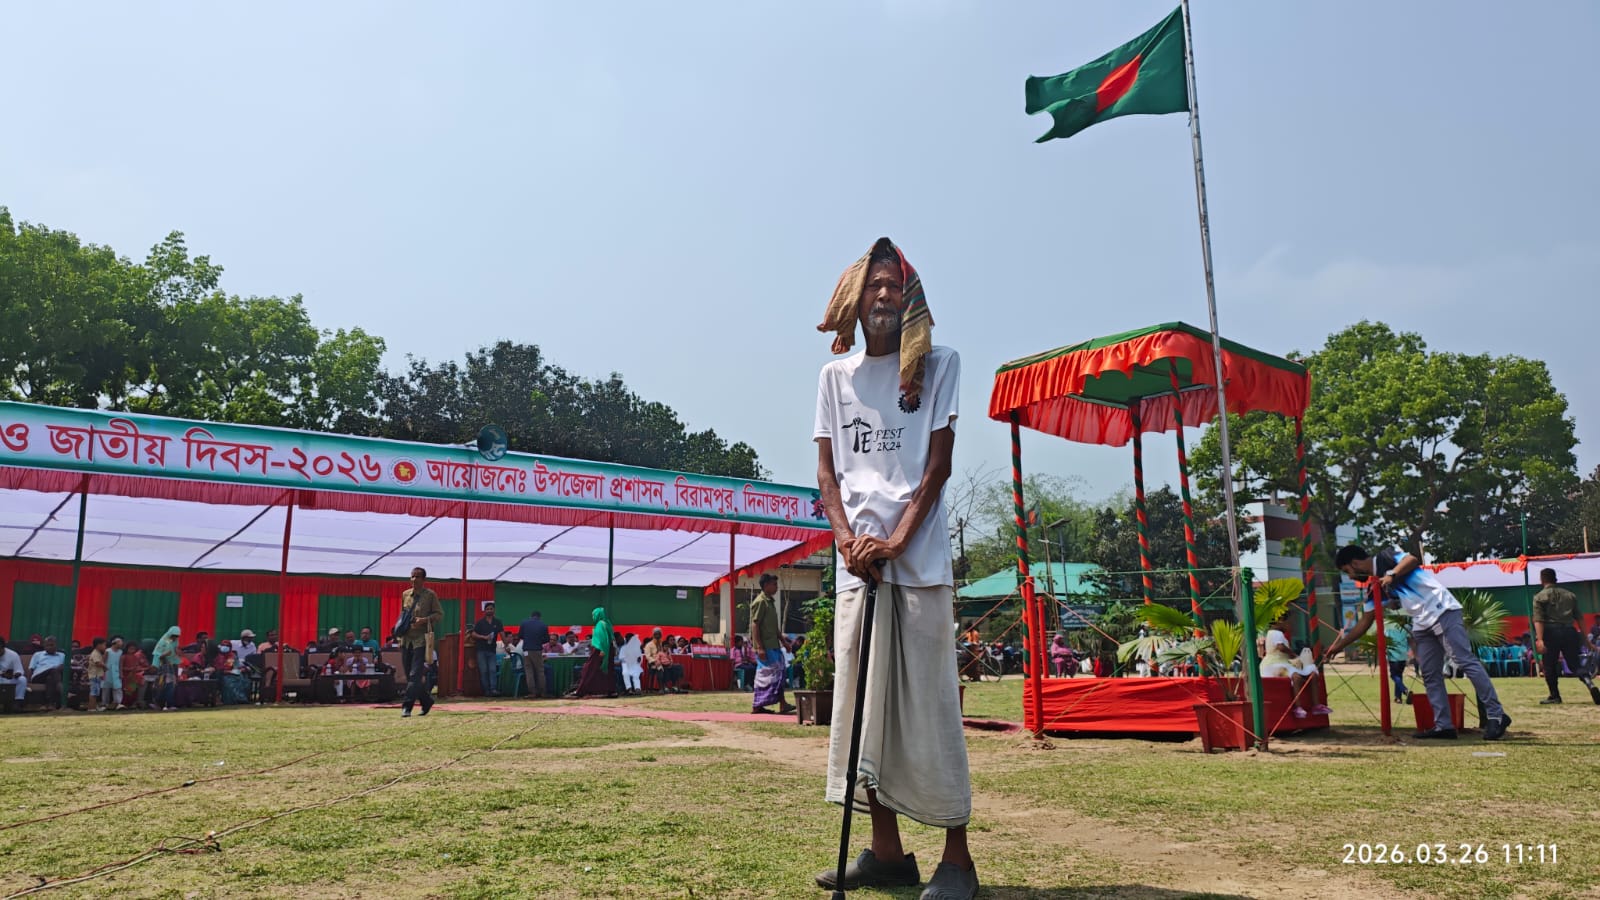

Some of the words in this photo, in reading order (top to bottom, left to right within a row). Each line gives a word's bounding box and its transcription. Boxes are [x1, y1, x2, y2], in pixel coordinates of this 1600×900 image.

[873, 427, 906, 442] FEST
[876, 441, 902, 452] 2K24
[0, 423, 30, 452] ও
[46, 418, 173, 467] জাতীয়
[181, 427, 382, 484] দিবস-২০২৬
[533, 461, 606, 499] উপজেলা
[610, 476, 669, 511] প্রশাসন,
[674, 475, 739, 516] বিরামপুর,
